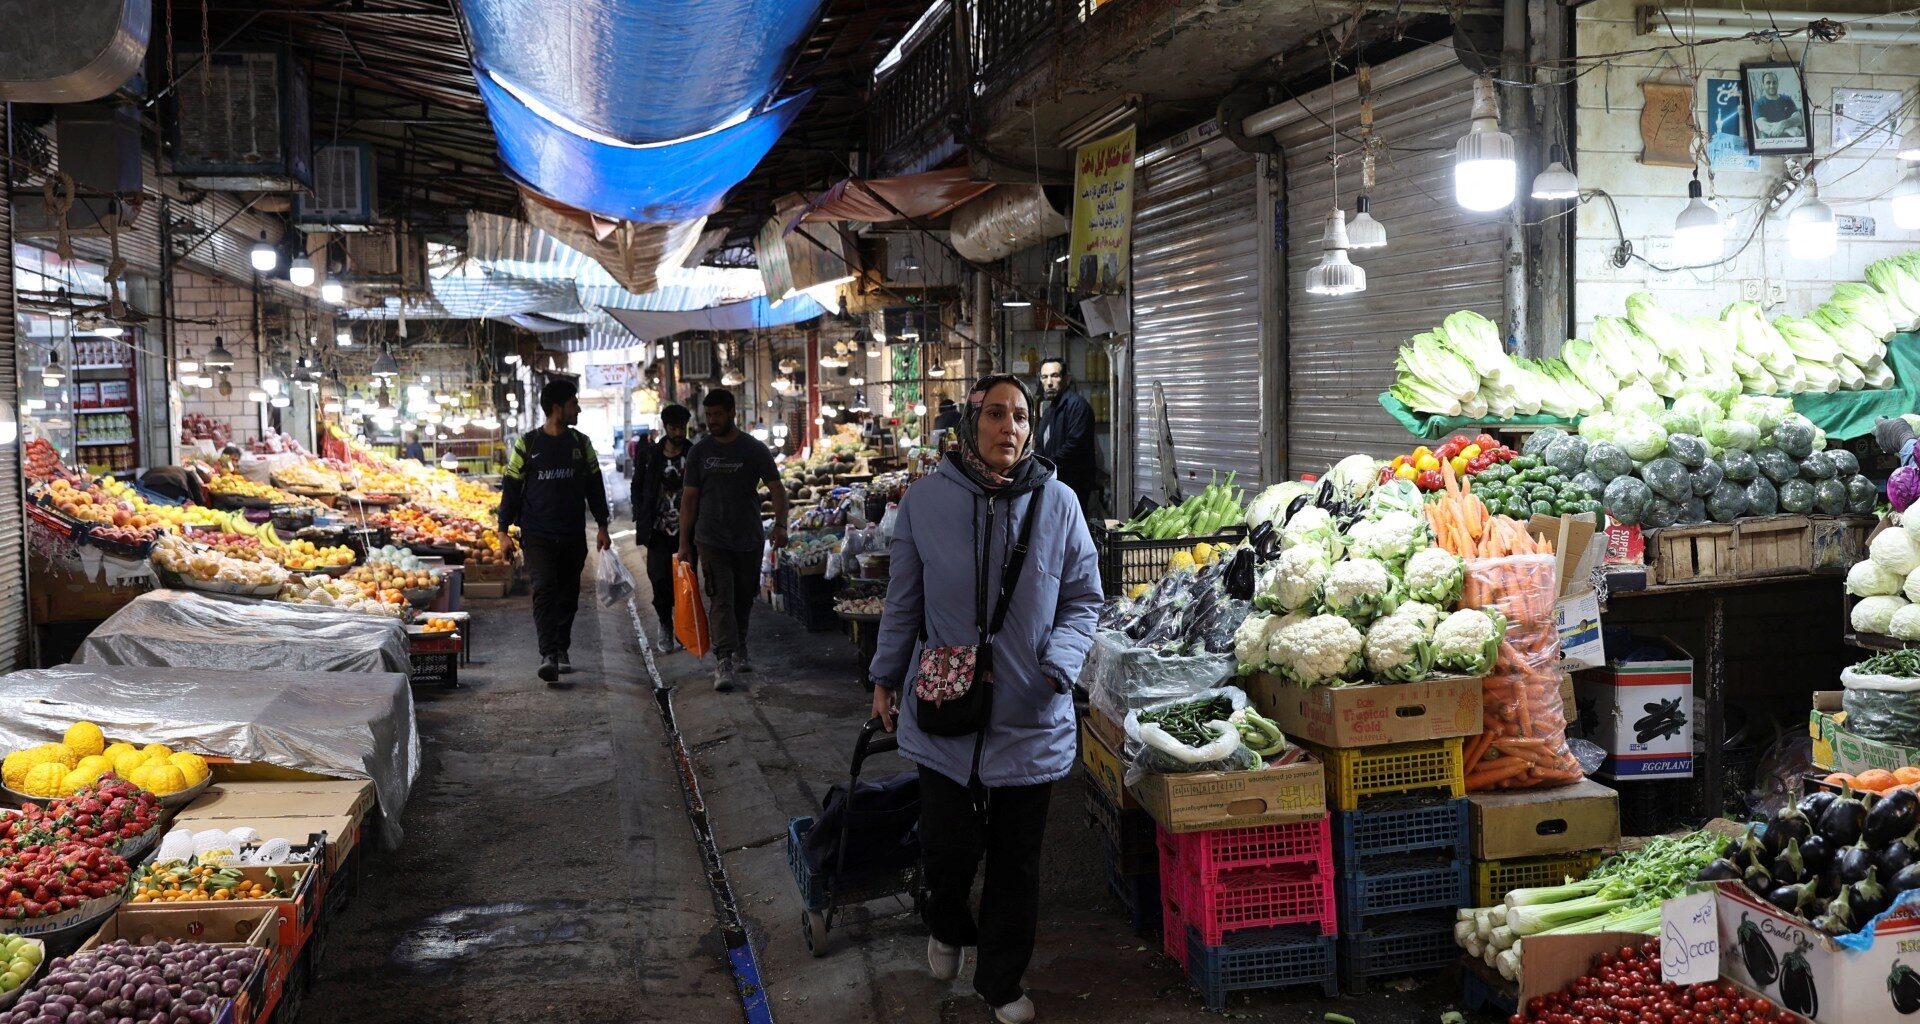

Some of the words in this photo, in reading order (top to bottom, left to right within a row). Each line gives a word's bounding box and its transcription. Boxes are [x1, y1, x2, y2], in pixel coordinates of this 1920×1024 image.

[1610, 529, 1621, 546] LUX
[1618, 530, 1630, 558] SUPER
[1343, 707, 1389, 721] Tropical
[1353, 721, 1383, 733] Gold
[1641, 760, 1692, 772] EGGPLANT
[1292, 770, 1319, 778] product
[63, 913, 81, 929] OF
[1761, 918, 1791, 942] Grade
[1793, 929, 1814, 950] One
